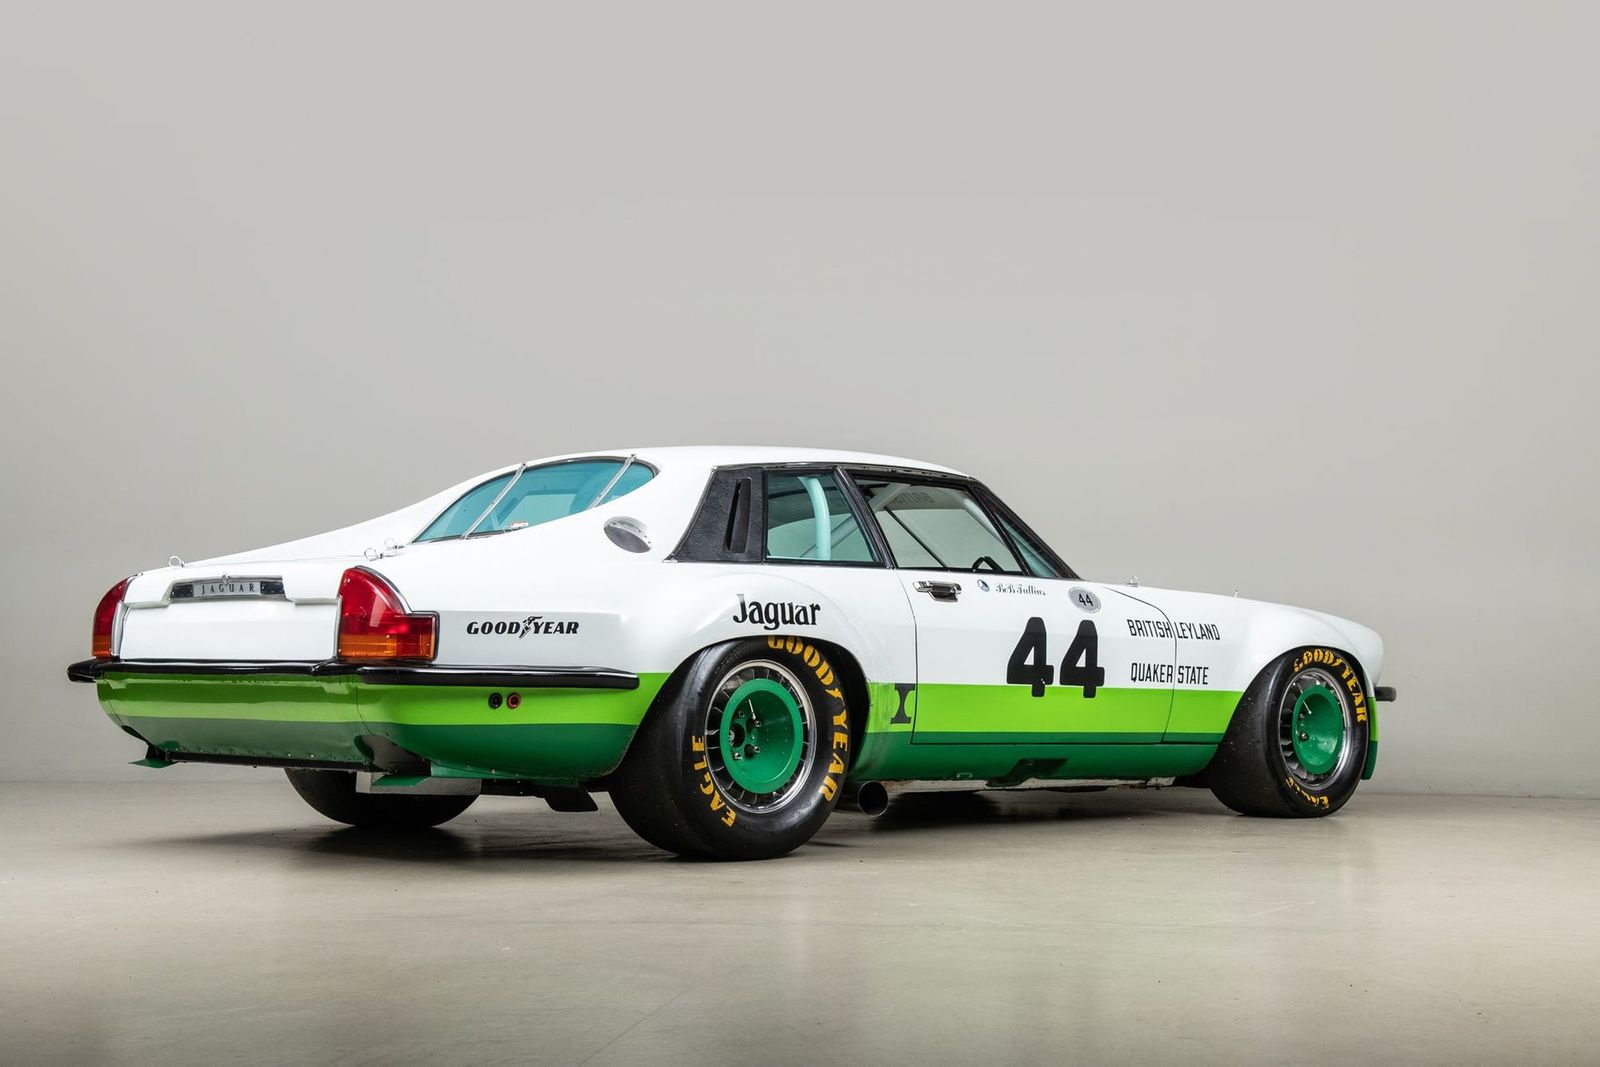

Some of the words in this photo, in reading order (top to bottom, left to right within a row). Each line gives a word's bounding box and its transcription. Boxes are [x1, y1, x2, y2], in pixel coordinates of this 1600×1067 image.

[201, 583, 254, 595] JAGUAR
[1079, 593, 1093, 606] 44
[732, 593, 821, 630] Jaguar
[1126, 619, 1173, 638] BRITISH
[1174, 621, 1220, 640] LEYLAND
[1006, 616, 1105, 698] 44
[1130, 662, 1174, 683] QUAKER
[1177, 665, 1209, 685] STATE
[692, 735, 737, 828] EAGLE
